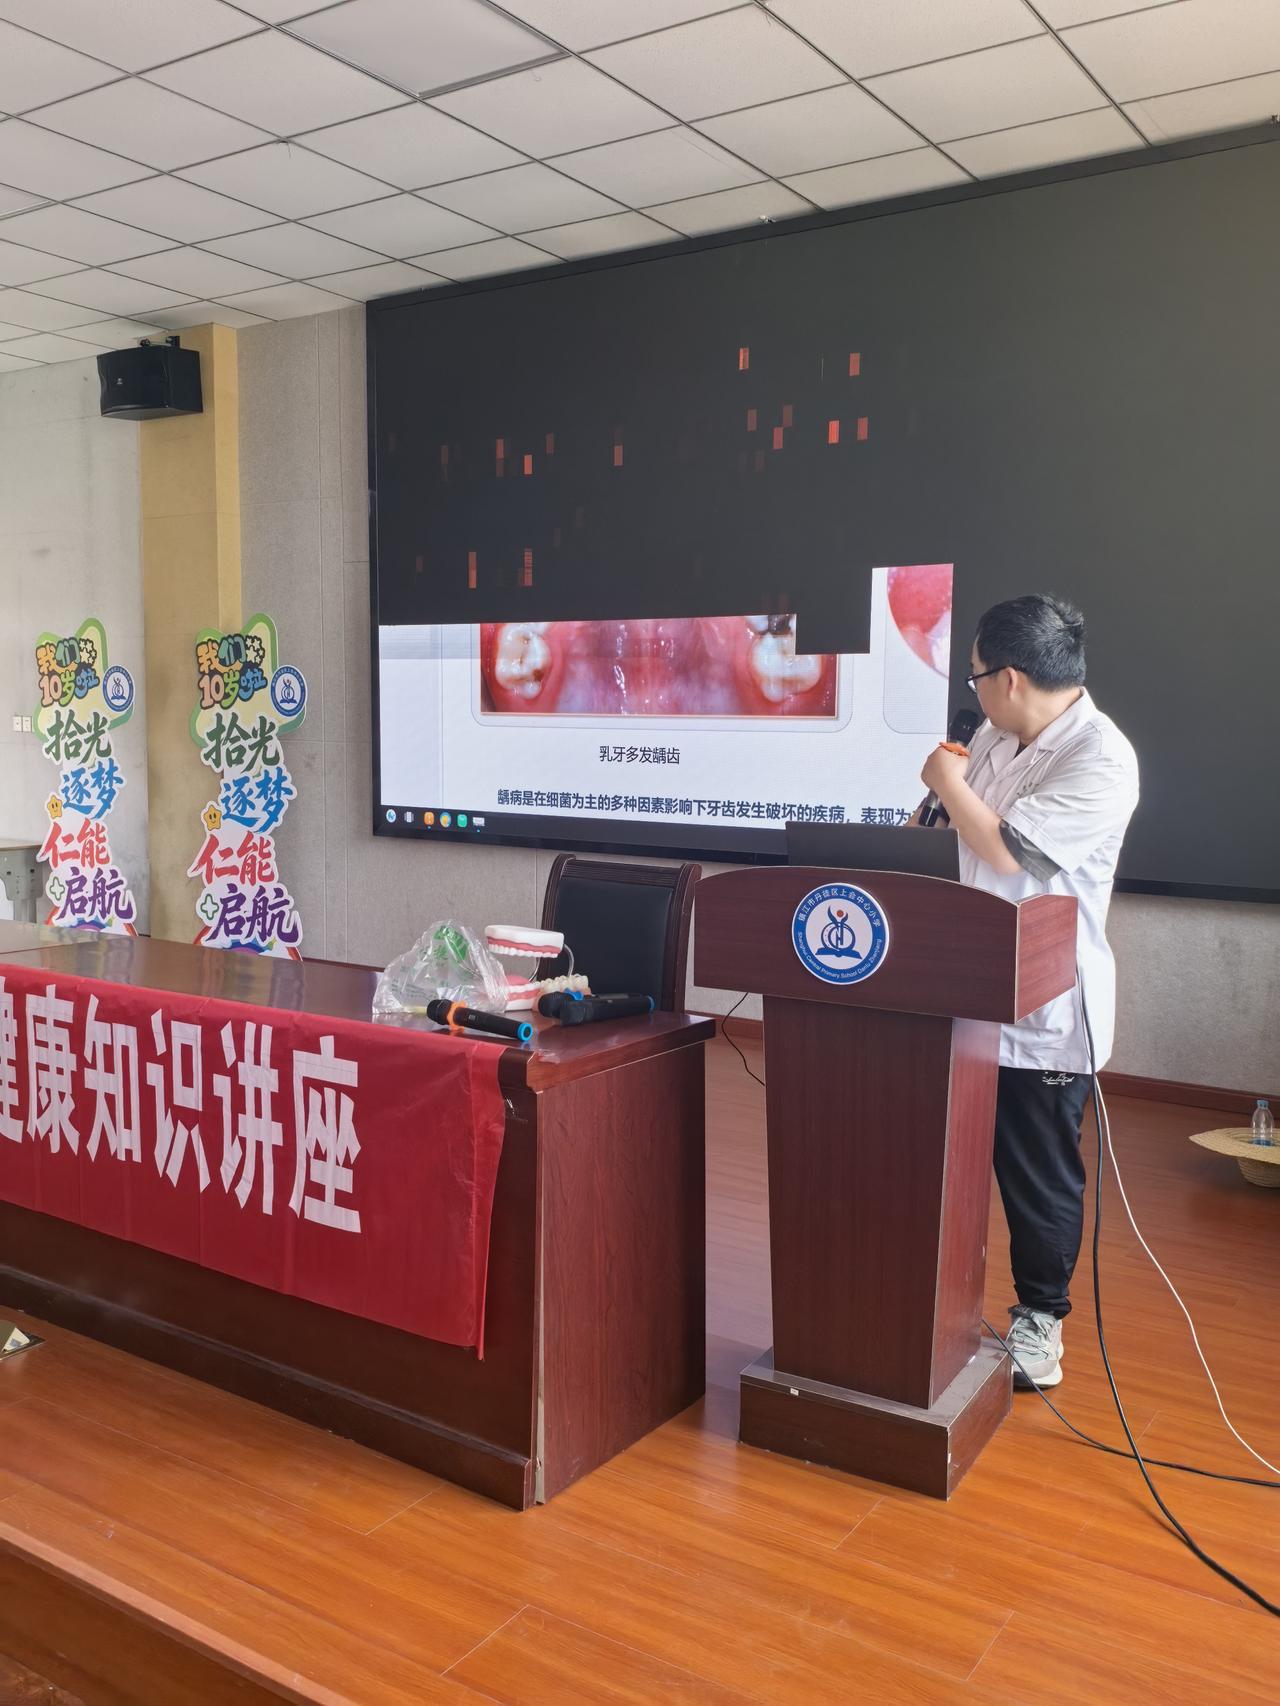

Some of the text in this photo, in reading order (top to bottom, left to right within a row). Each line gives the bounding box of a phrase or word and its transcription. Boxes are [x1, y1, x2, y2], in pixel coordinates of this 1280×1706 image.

[36, 638, 81, 675] 我们
[196, 634, 247, 674] 我们
[39, 667, 100, 707] 10岁啦
[198, 667, 268, 710] 10岁啦
[44, 710, 112, 764] 拾光
[202, 713, 280, 772] 拾光
[599, 745, 681, 765] 乳牙多发龋齿
[61, 758, 124, 819] 逐梦
[220, 768, 293, 832] 逐梦
[497, 788, 915, 826] 龋病是在细菌为主的多种因素影响下牙齿发生破坏的疾病，表现为
[40, 819, 110, 868] 仁能
[190, 833, 275, 885] 仁能
[55, 867, 134, 921] 启航
[206, 883, 299, 943] 启航
